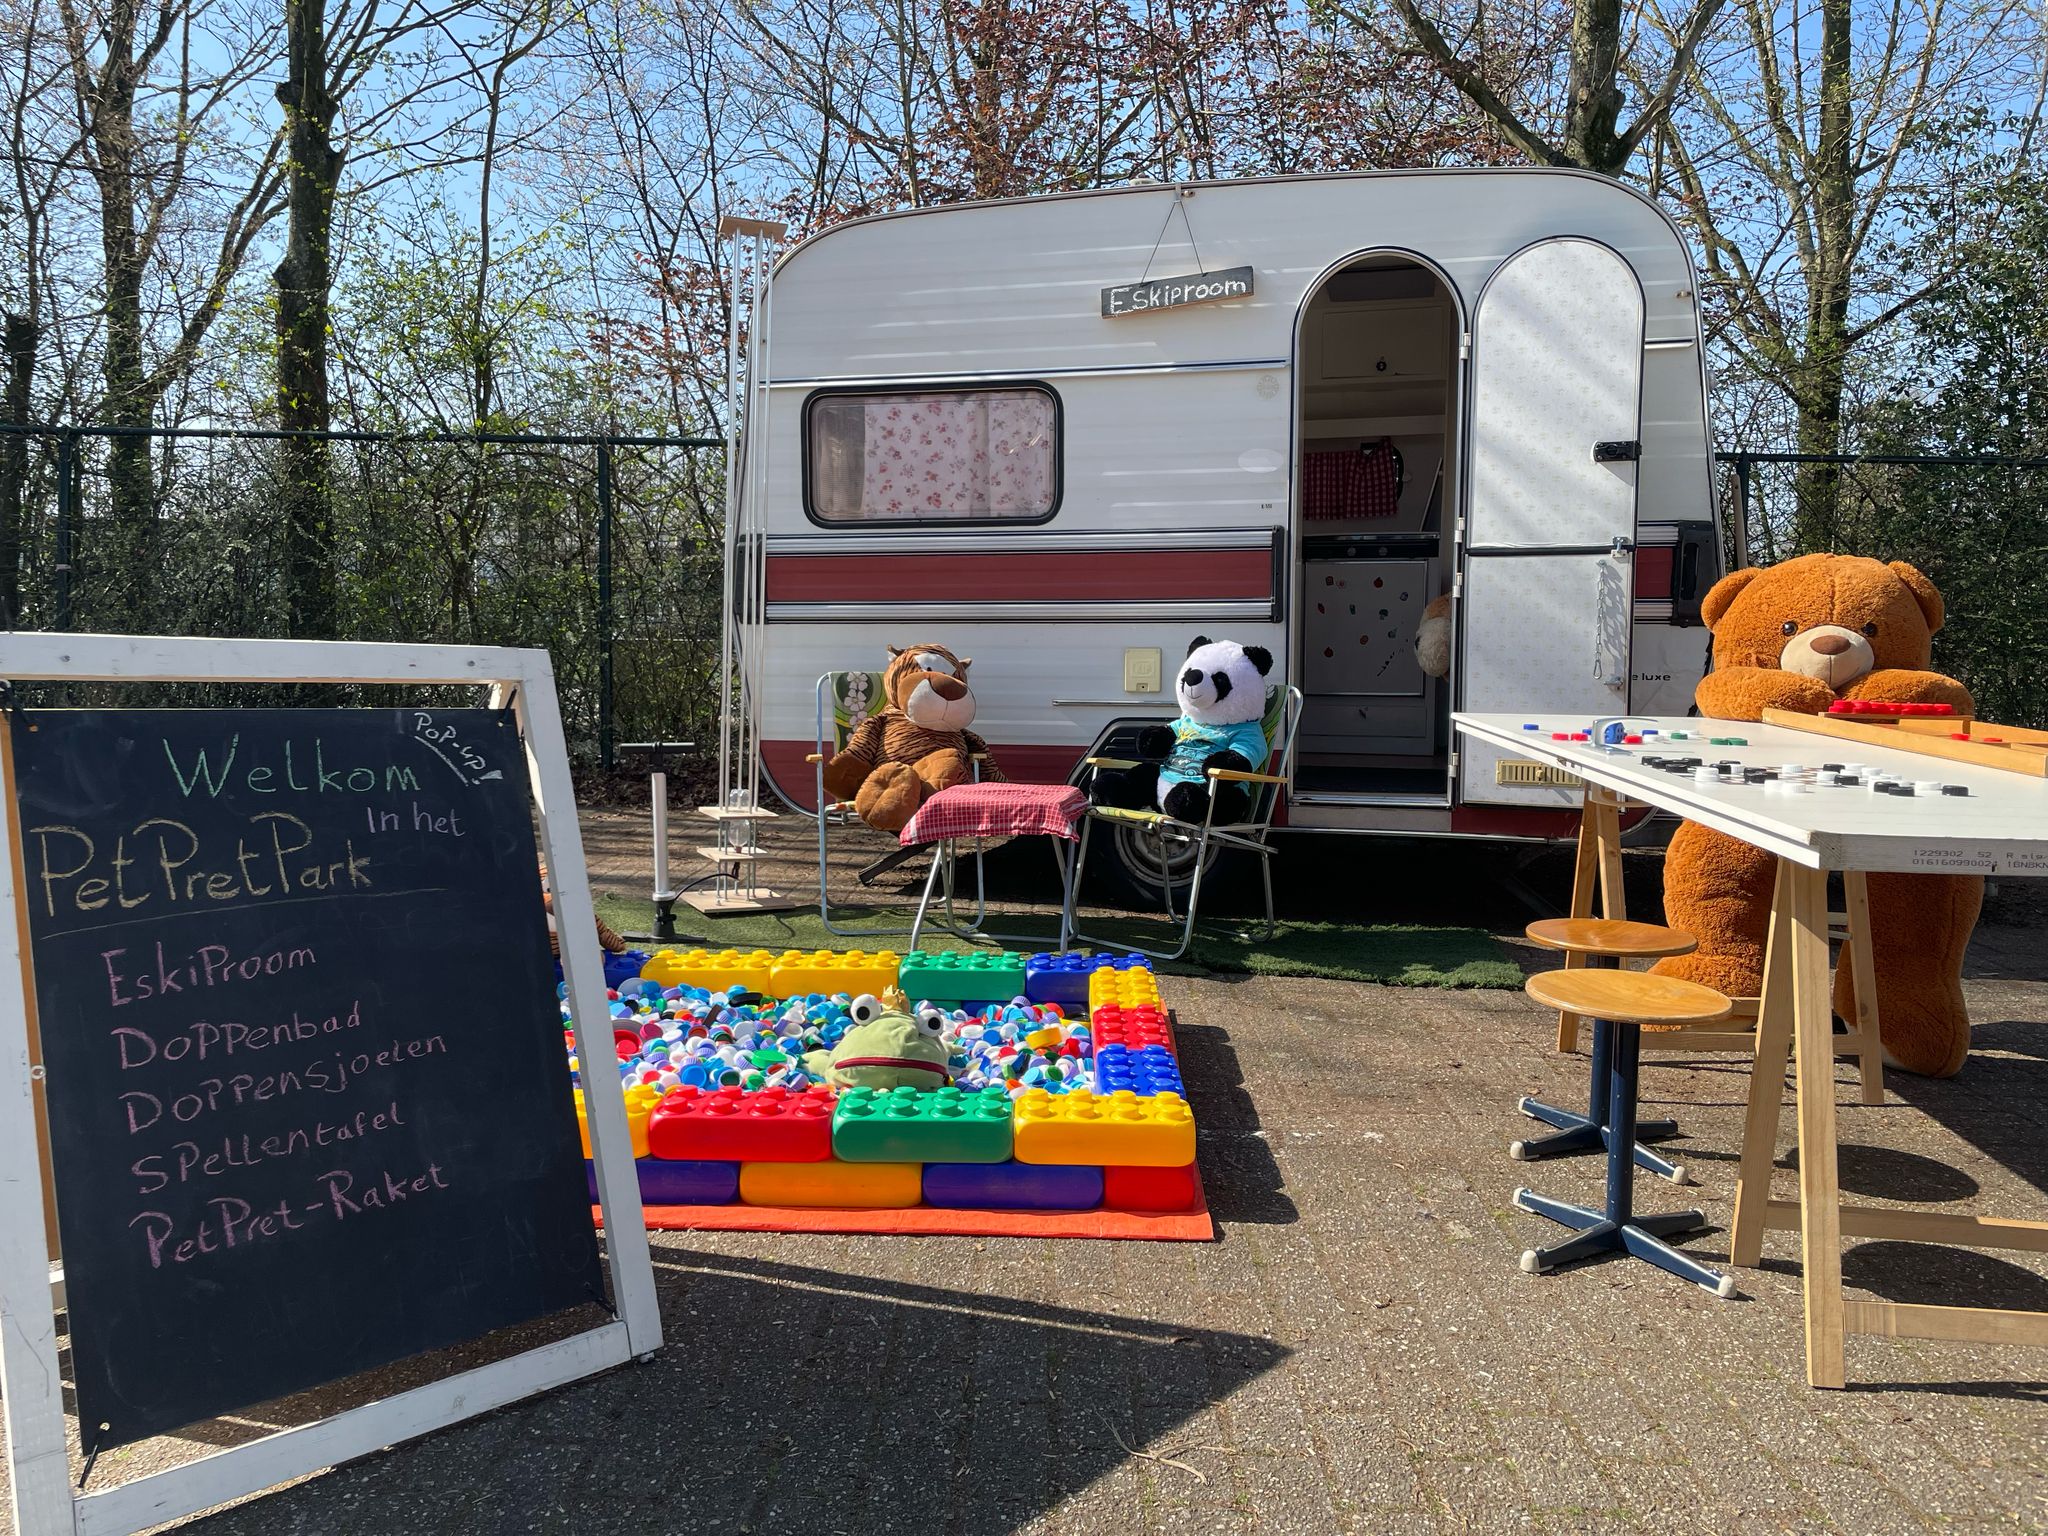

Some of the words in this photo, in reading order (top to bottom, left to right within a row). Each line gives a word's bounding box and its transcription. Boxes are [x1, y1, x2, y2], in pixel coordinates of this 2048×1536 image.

[1641, 672, 1671, 681] luxe
[163, 733, 421, 798] Welkom
[413, 800, 466, 837] het
